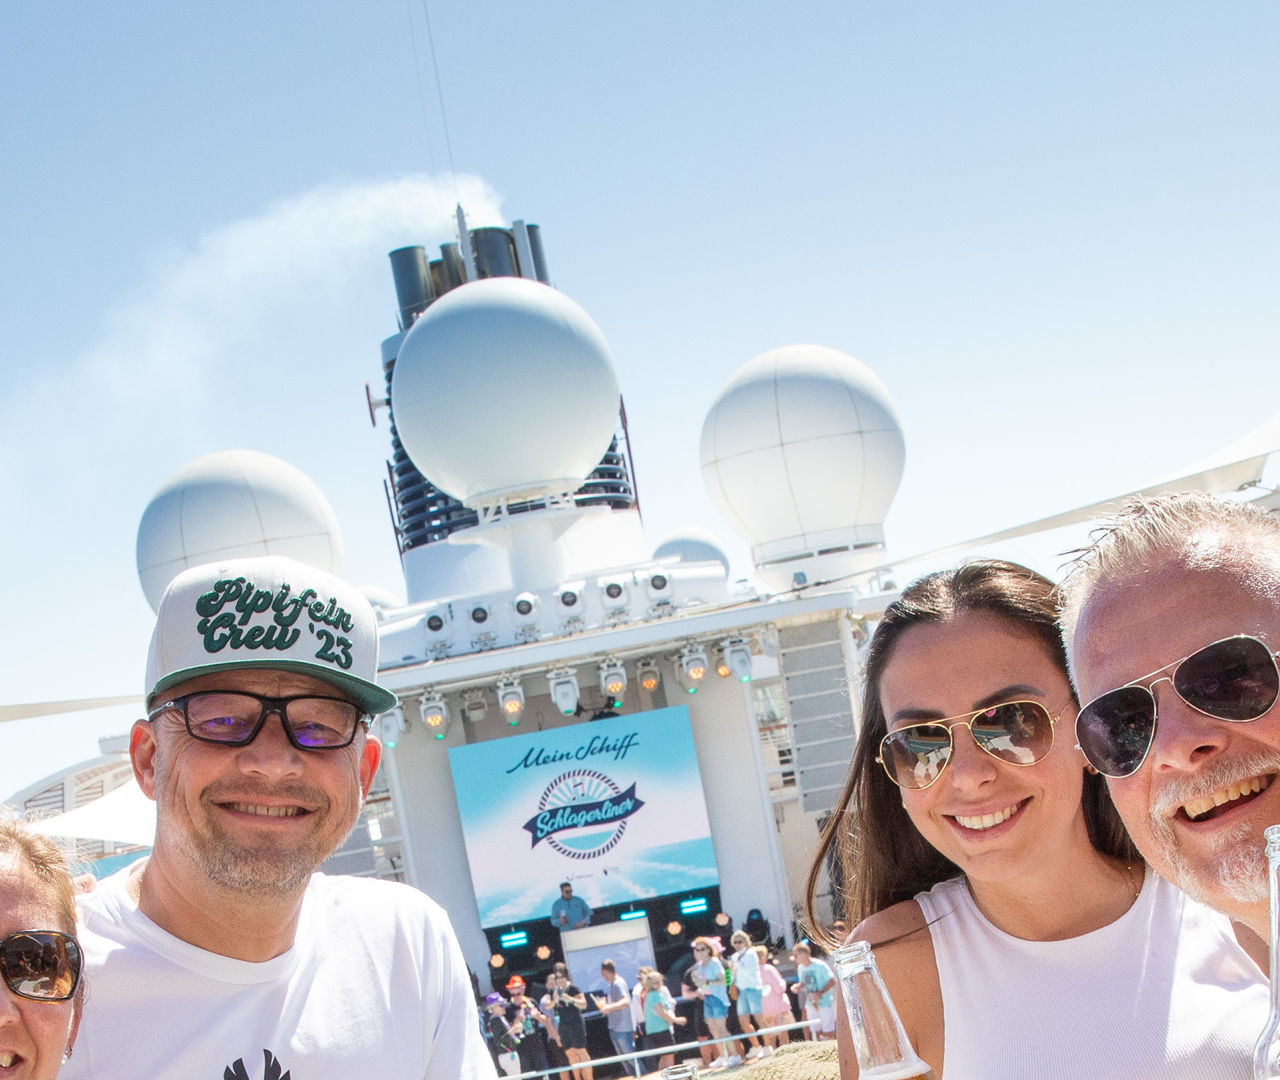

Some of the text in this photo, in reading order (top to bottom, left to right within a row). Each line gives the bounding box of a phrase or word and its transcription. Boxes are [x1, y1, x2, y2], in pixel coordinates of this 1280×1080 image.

[196, 612, 354, 669] Crew '23
[506, 732, 640, 774] Mein Schiff
[535, 797, 635, 838] Schlagerliner
